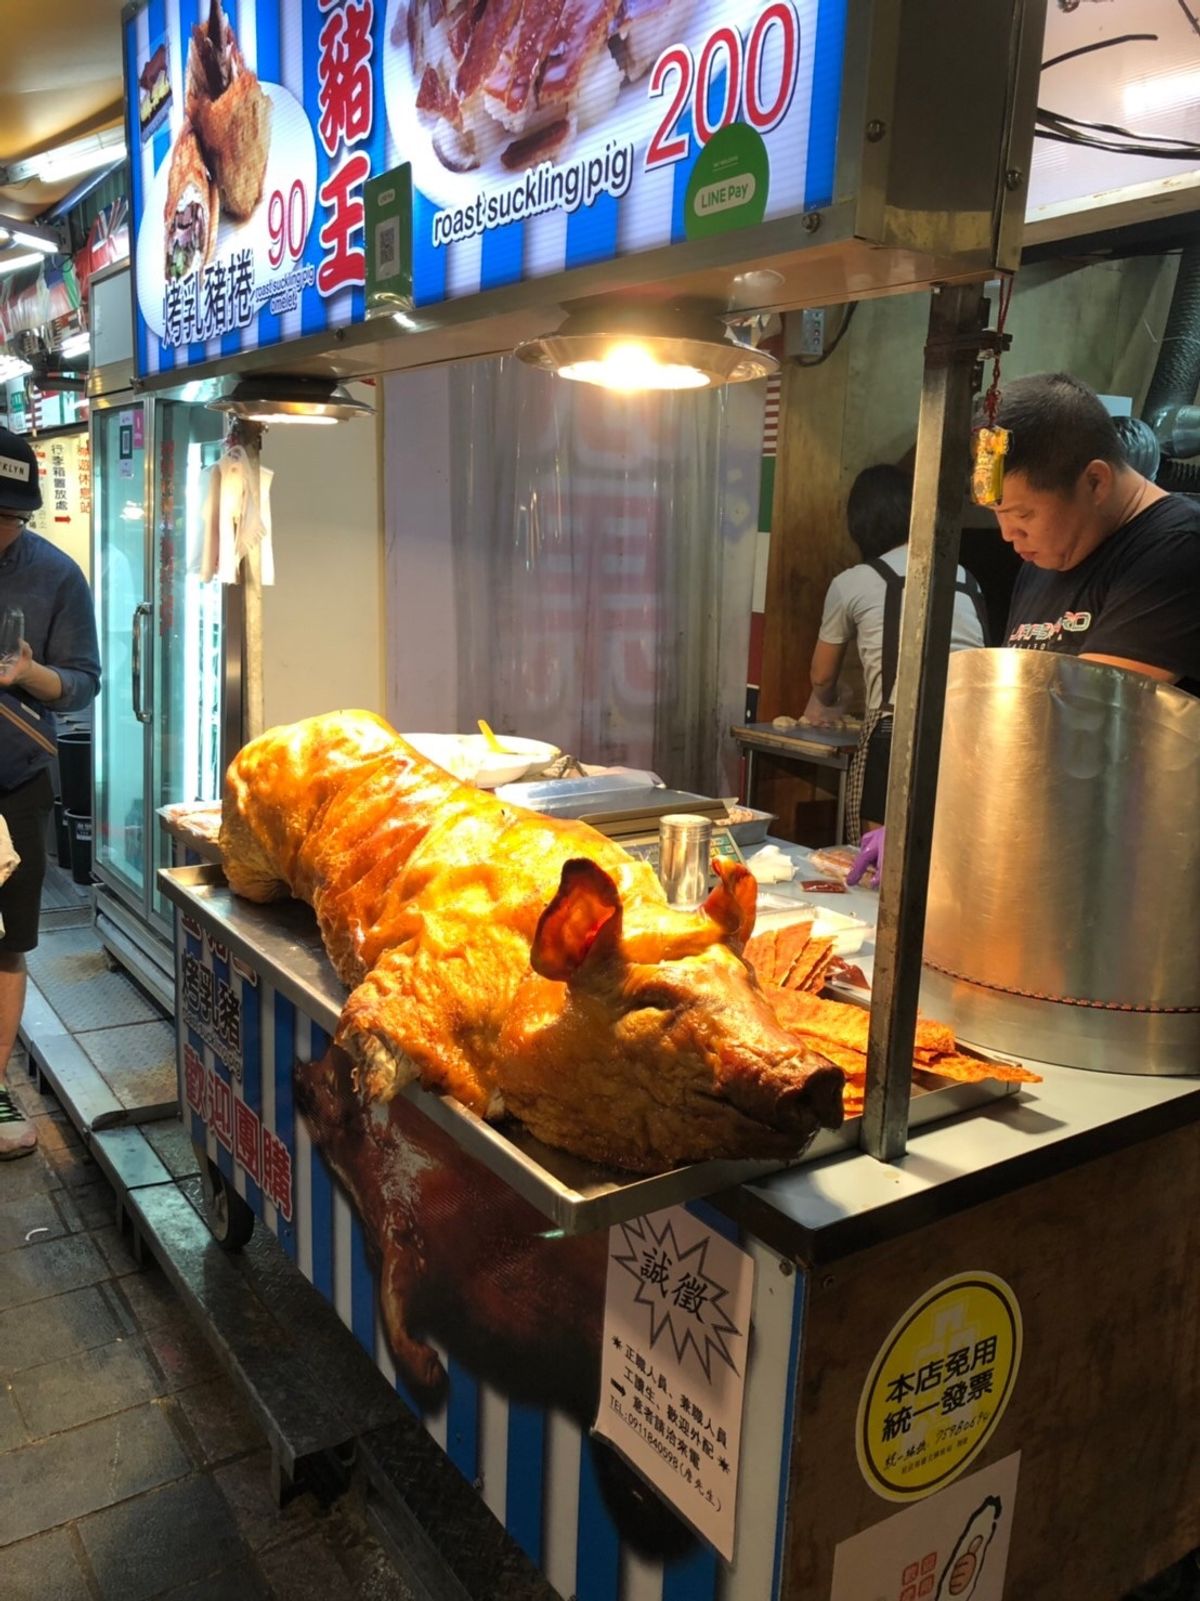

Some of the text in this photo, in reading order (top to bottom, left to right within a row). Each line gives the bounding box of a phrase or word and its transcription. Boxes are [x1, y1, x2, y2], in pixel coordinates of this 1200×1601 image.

[645, 2, 797, 170] 200
[319, 0, 373, 297] 豬王
[434, 144, 629, 242] roast suckling pig
[268, 179, 308, 267] 90
[701, 183, 749, 208] LINE Pay
[162, 248, 254, 346] 烤乳豬捲
[0, 461, 25, 476] KLYN
[182, 947, 242, 1056] 烤乳豬
[183, 1043, 292, 1220] 歡迎團購
[640, 1247, 706, 1325] 誠徵
[881, 1367, 995, 1442] 統一發票
[885, 1334, 998, 1403] 本店免用
